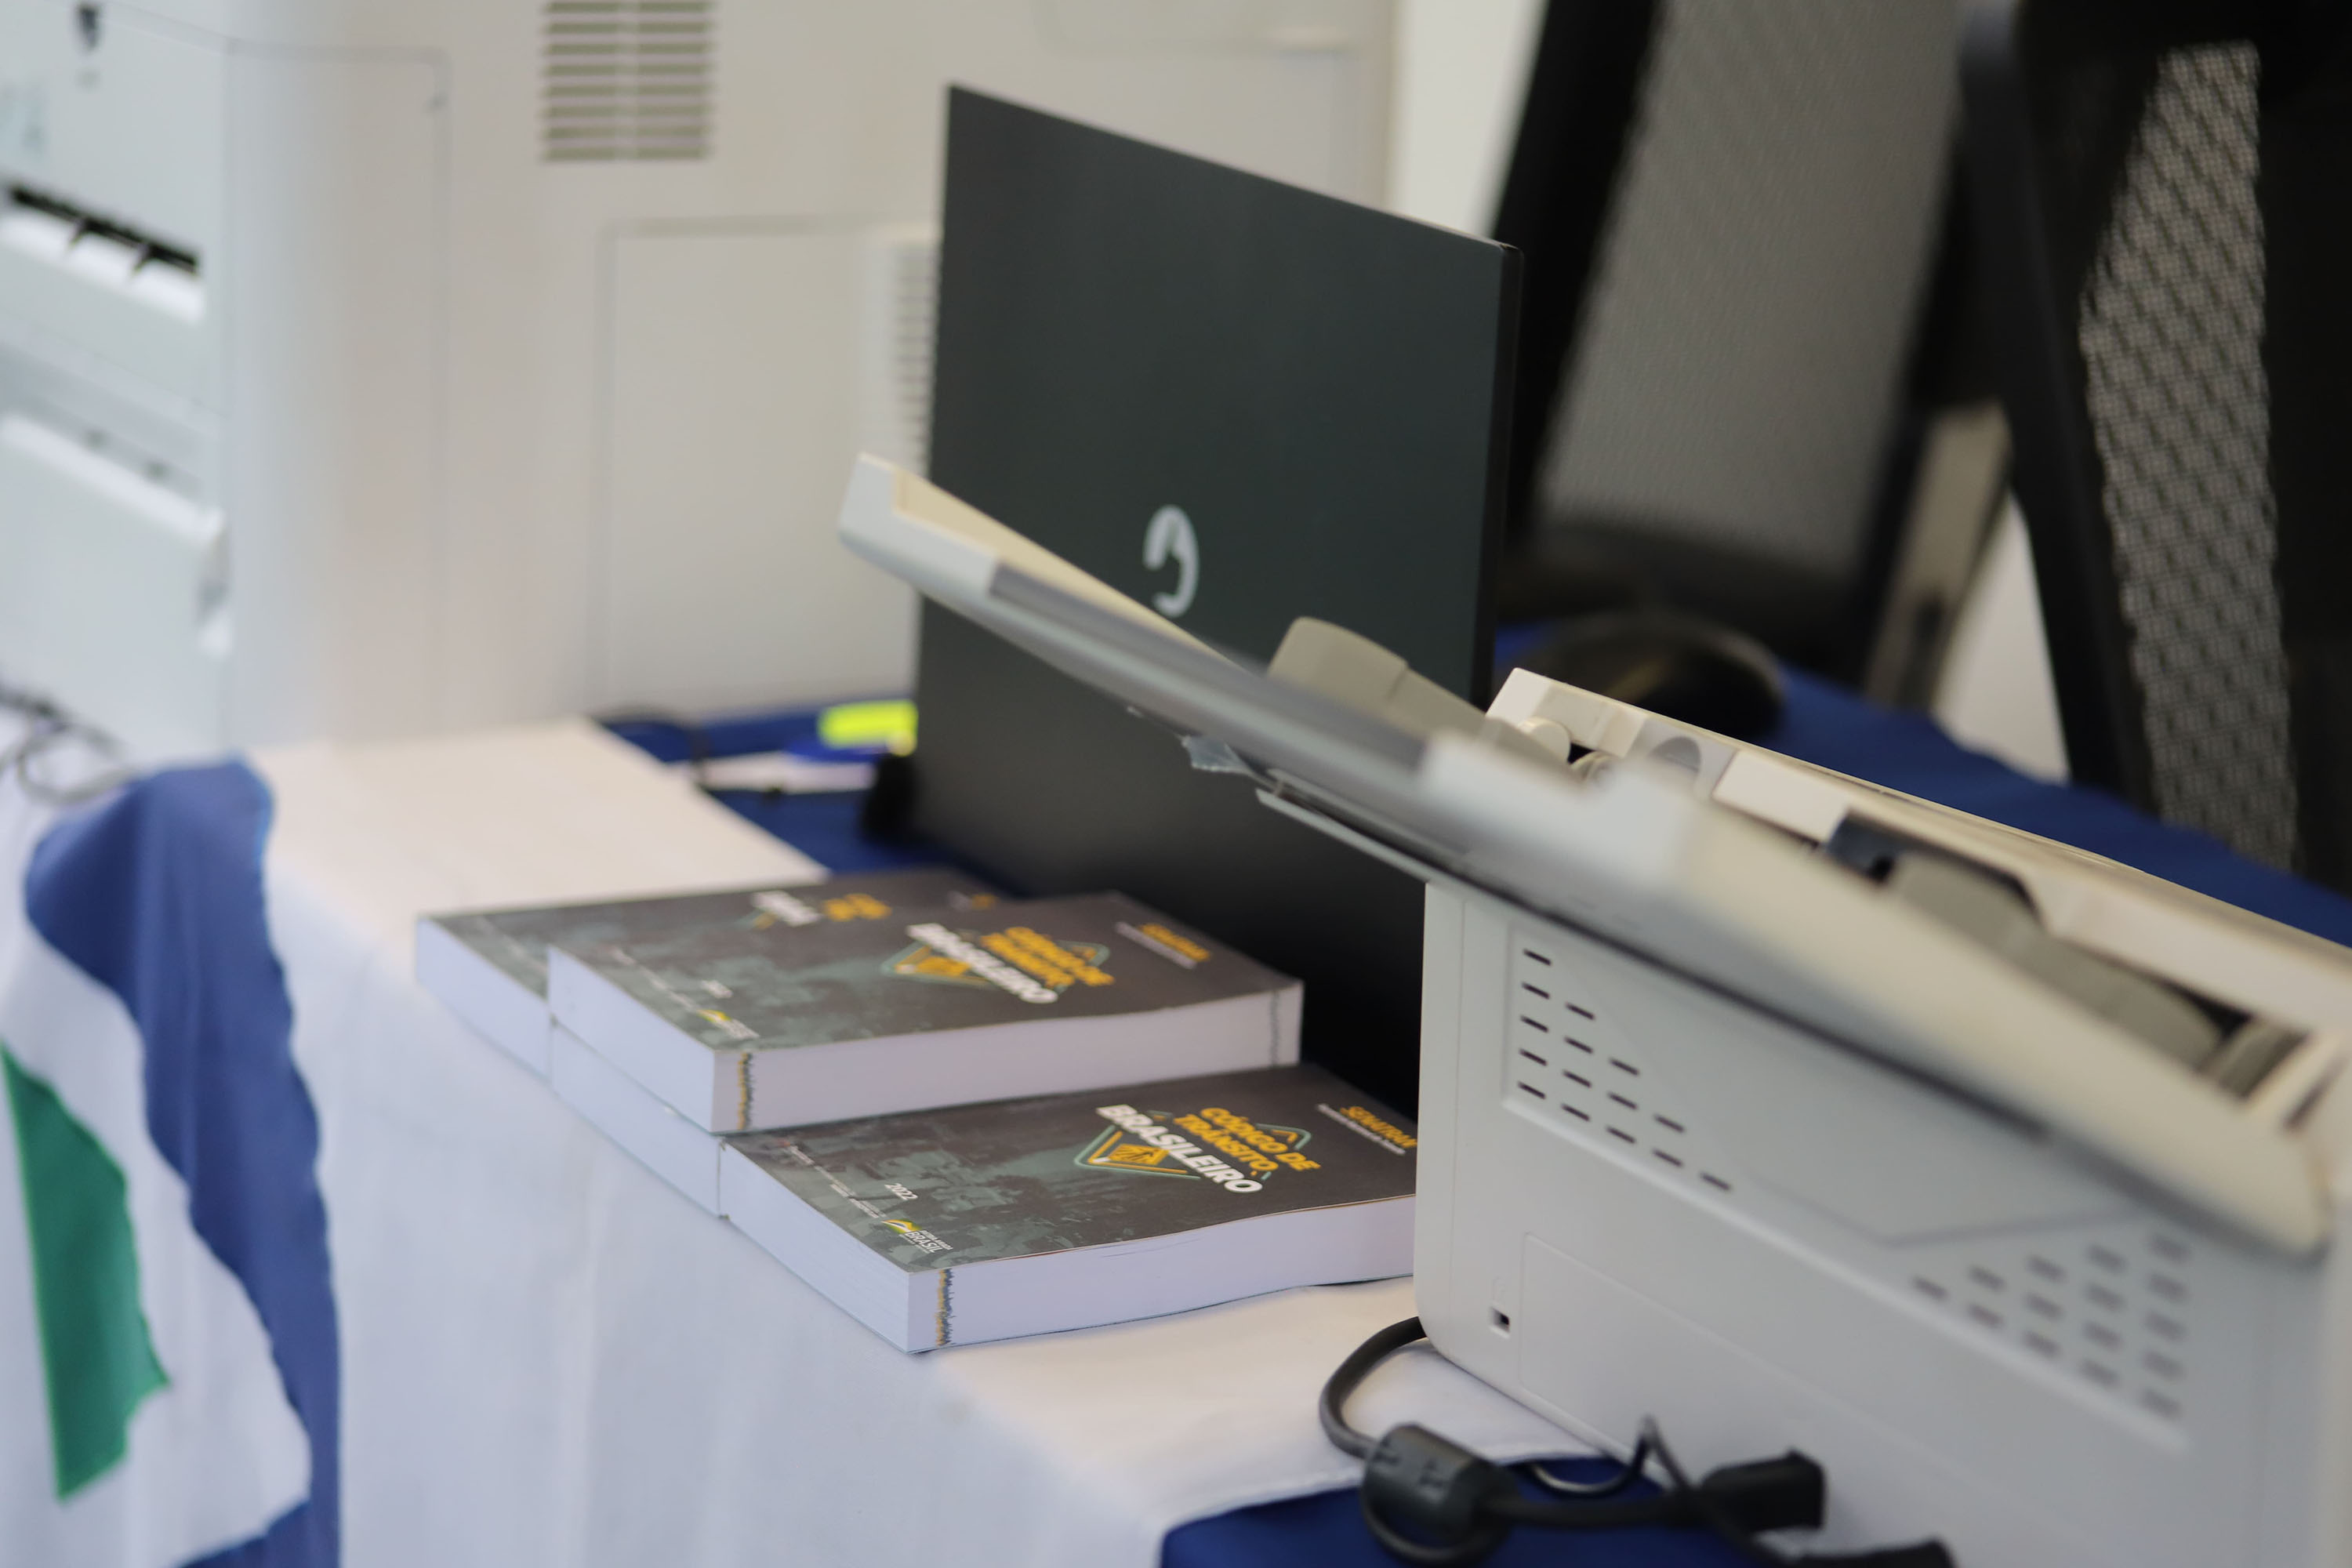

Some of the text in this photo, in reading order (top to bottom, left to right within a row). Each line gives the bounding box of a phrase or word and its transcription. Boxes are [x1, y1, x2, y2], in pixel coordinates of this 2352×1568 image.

[1096, 1104, 1263, 1193] BRASILEIRO
[1200, 1107, 1288, 1161] CÓDIGO
[1275, 1152, 1322, 1171] DE
[884, 1182, 919, 1201] 2022
[904, 1231, 943, 1253] BRASIL
